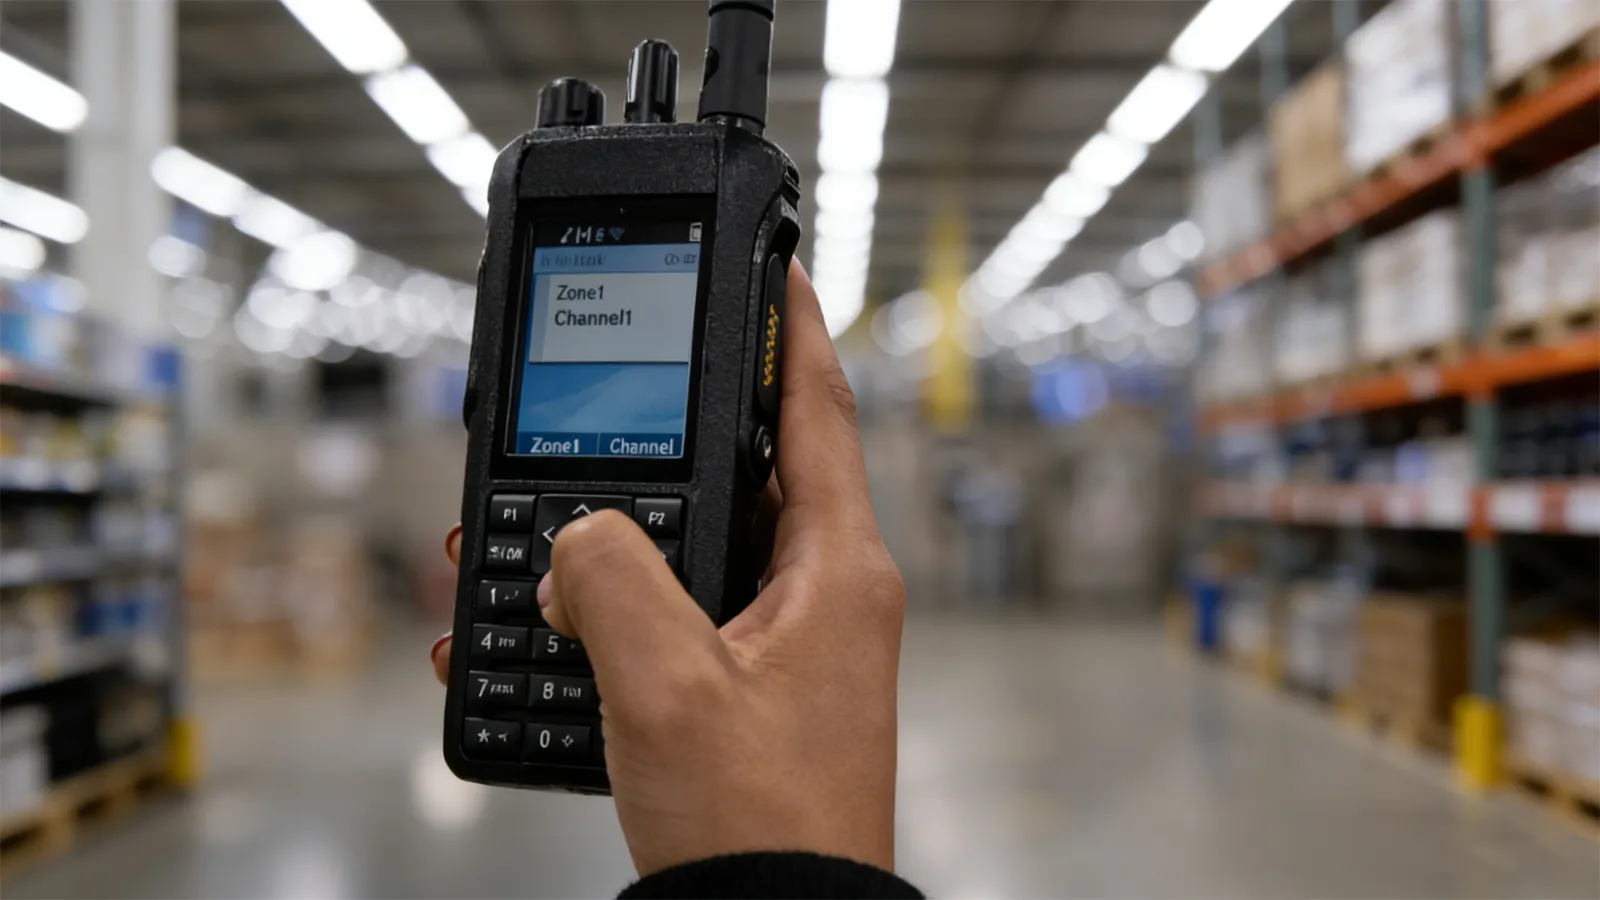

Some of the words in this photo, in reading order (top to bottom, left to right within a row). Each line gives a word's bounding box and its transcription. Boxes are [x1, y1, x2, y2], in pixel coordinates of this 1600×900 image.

[556, 285, 604, 301] Zone1
[554, 309, 632, 326] Channel1
[530, 437, 580, 454] Zone1
[610, 438, 674, 455] Channel
[503, 508, 517, 521] P1
[490, 587, 496, 605] 1
[481, 631, 492, 650] 4
[547, 635, 559, 653] 5
[477, 678, 489, 697] 7
[542, 682, 554, 699] 8
[540, 730, 551, 748] 0
